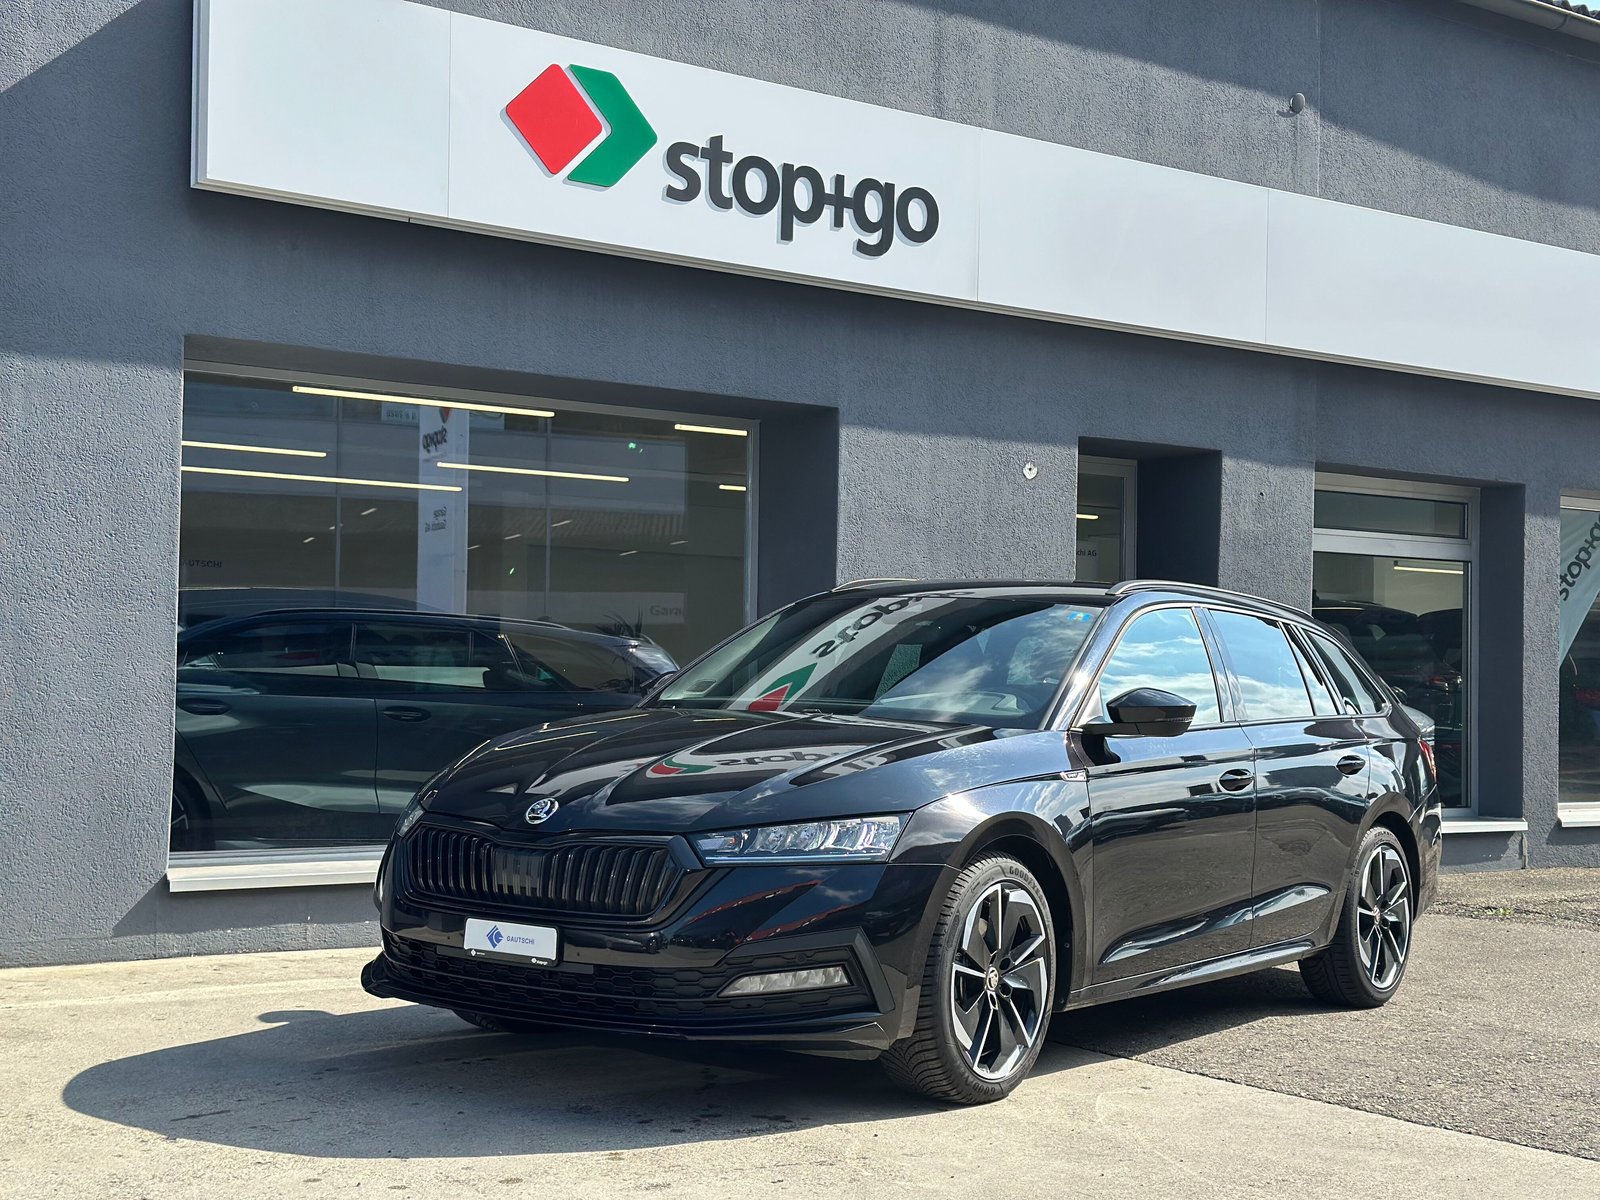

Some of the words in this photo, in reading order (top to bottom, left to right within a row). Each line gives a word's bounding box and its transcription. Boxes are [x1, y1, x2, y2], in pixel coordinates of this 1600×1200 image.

[665, 134, 940, 257] stop+go
[181, 559, 223, 568] UTSCHI
[1560, 513, 1600, 602] stop+g
[650, 604, 685, 617] Gara
[506, 935, 535, 945] GAUTSCHI
